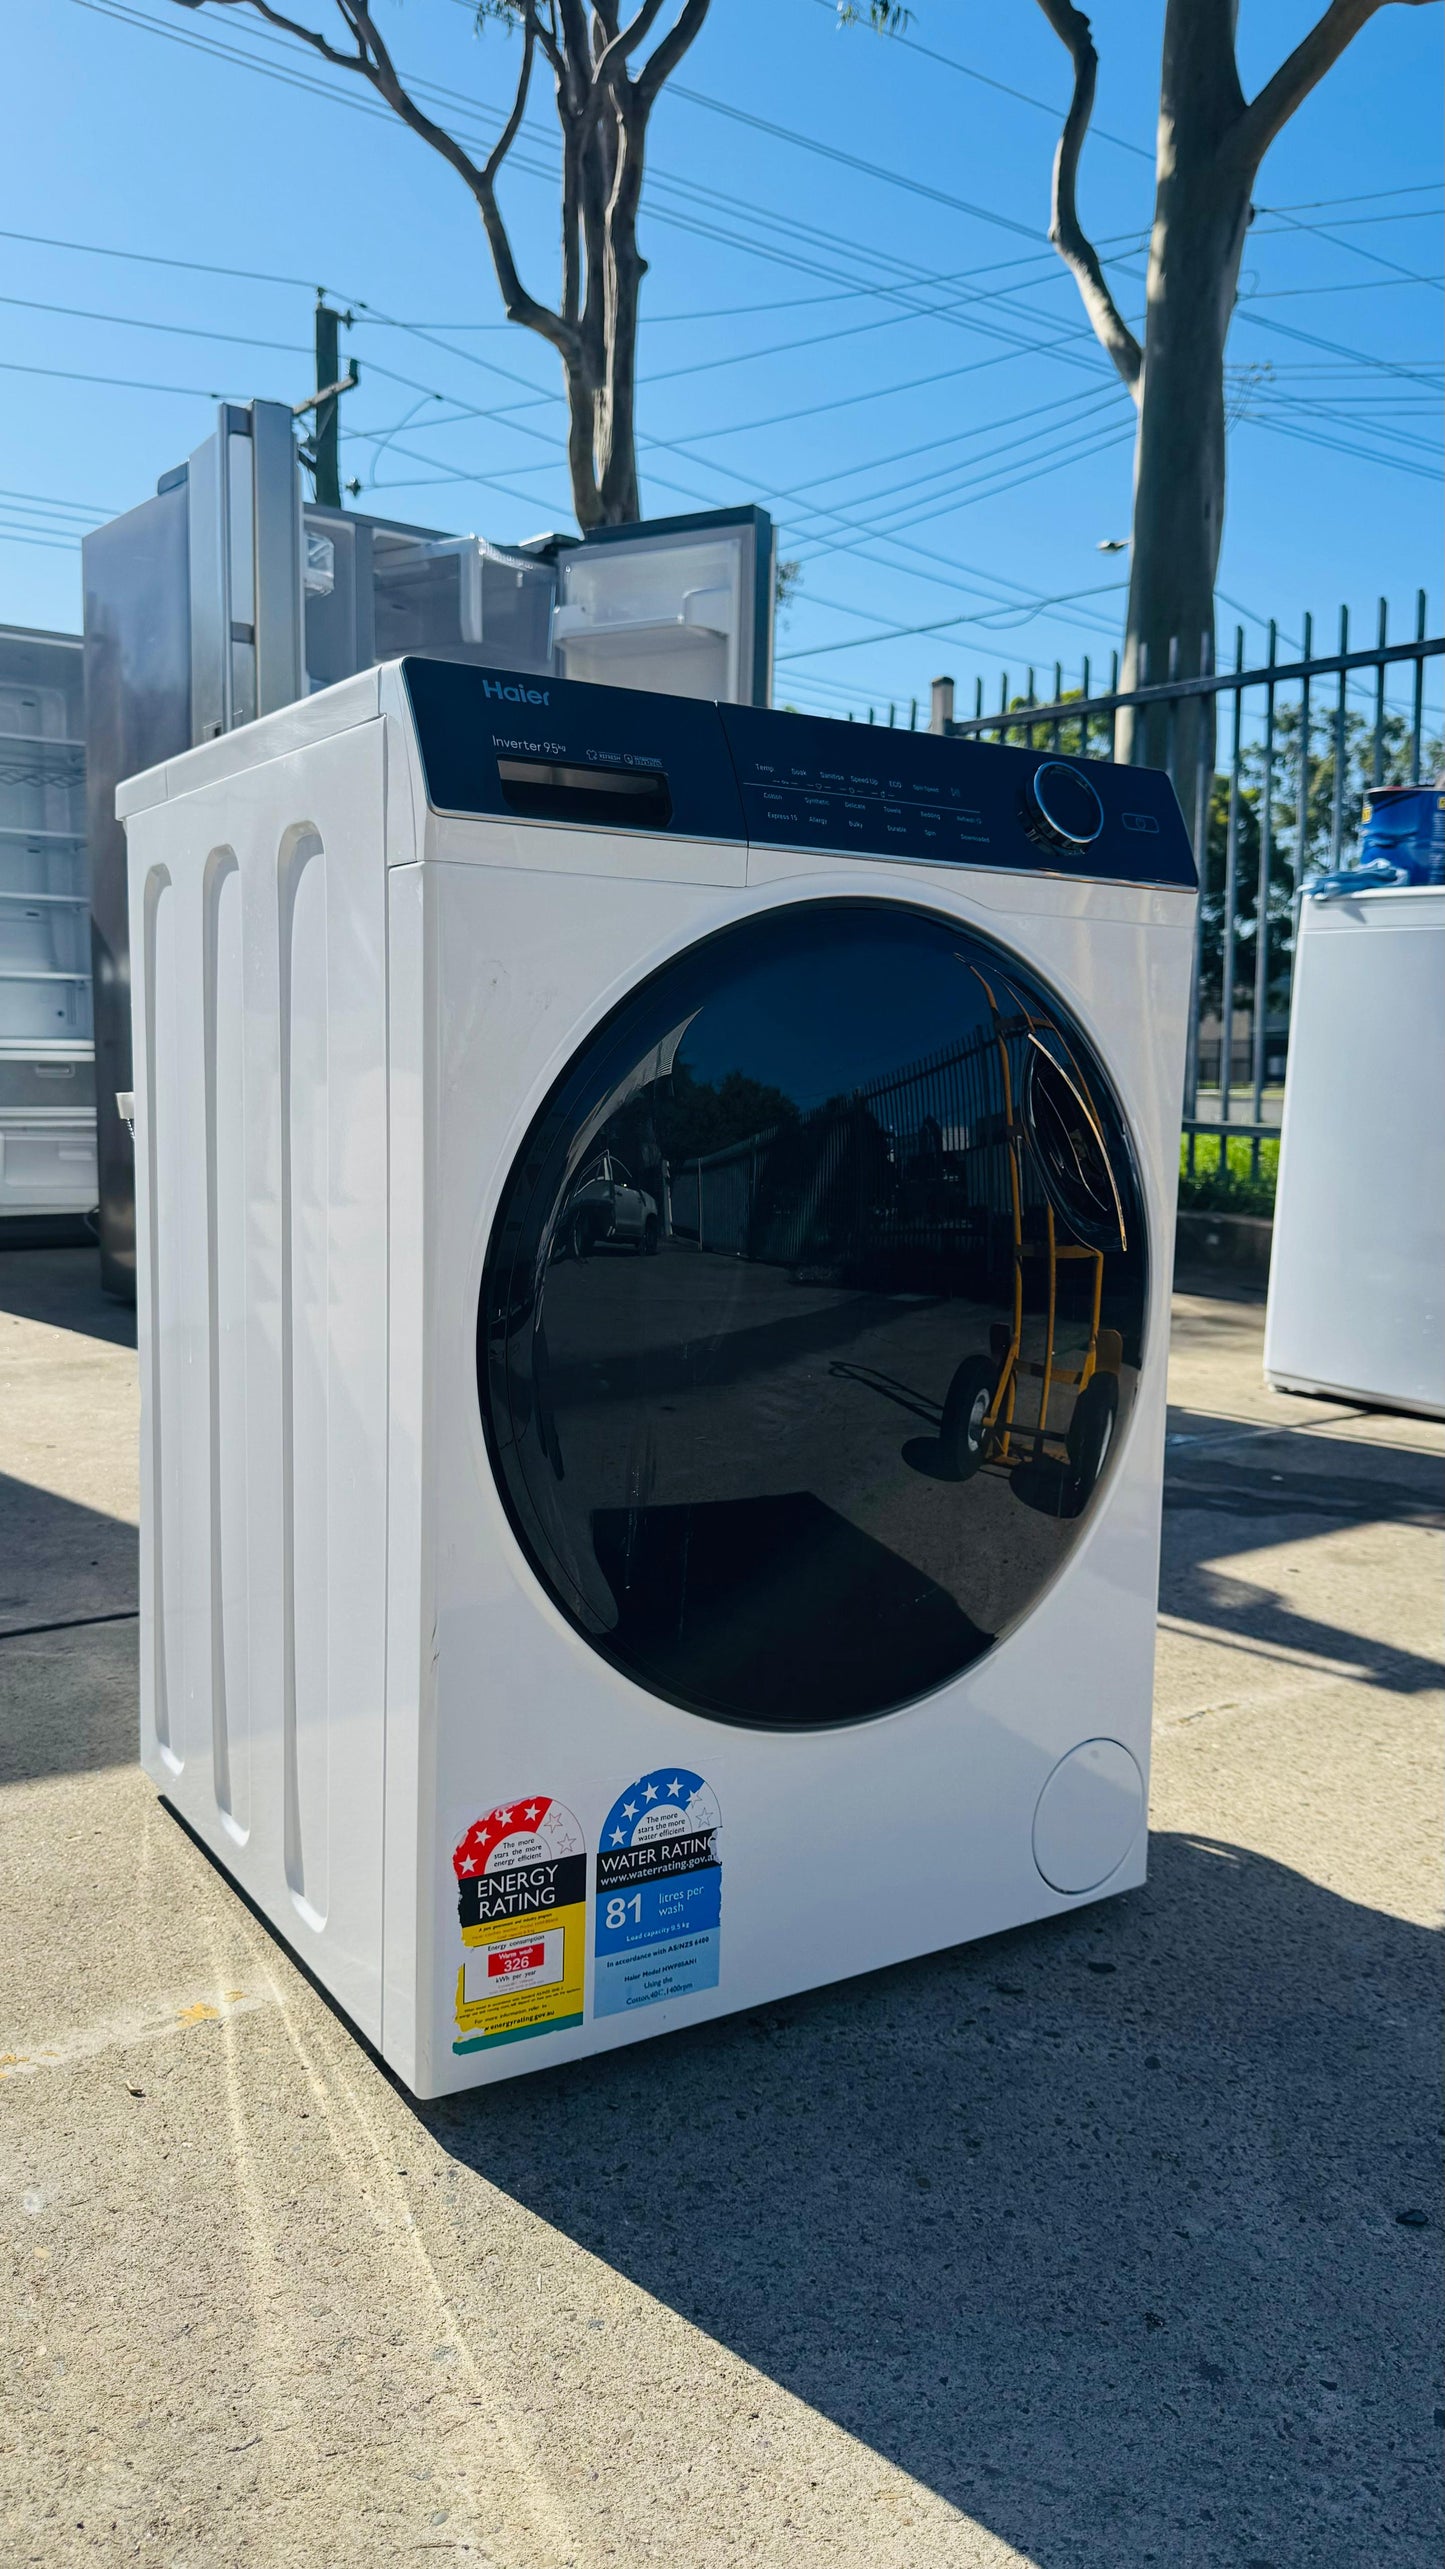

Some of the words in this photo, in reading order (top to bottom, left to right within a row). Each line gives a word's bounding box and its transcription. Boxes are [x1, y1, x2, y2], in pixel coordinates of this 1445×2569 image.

[482, 679, 549, 706] Haier
[492, 735, 541, 751] Inverter
[767, 811, 789, 821] Express
[646, 1816, 659, 1824] The
[660, 1812, 678, 1821] more
[638, 1825, 655, 1834] stars
[655, 1822, 667, 1830] the
[668, 1819, 686, 1829] more
[638, 1832, 658, 1842] water
[659, 1826, 685, 1837] efficient
[518, 1838, 535, 1846] more
[494, 1851, 509, 1860] stars
[512, 1848, 522, 1856] the
[525, 1845, 542, 1853] more
[494, 1858, 515, 1867] energy
[517, 1852, 542, 1862] efficient
[601, 1848, 657, 1873] WATER
[477, 1864, 559, 1899] ENERGY
[479, 1886, 556, 1920] RATING
[605, 1893, 642, 1929] 81
[659, 1890, 684, 1904] litres
[686, 1886, 704, 1900] per
[658, 1903, 684, 1916] wash
[626, 1932, 642, 1942] Load
[644, 1927, 670, 1938] capacity
[681, 1921, 690, 1929] kg
[487, 1943, 506, 1952] Energy
[509, 1935, 545, 1947] consumption
[499, 1951, 517, 1960] Warm
[615, 1952, 651, 1966] accordance
[653, 1948, 667, 1957] with
[504, 1956, 530, 1973] 326
[496, 1975, 510, 1983] kWh
[512, 1972, 522, 1981] per
[524, 1970, 537, 1978] year
[624, 1974, 641, 1982] Haier
[642, 1968, 661, 1978] Model
[644, 1980, 661, 1989] Using
